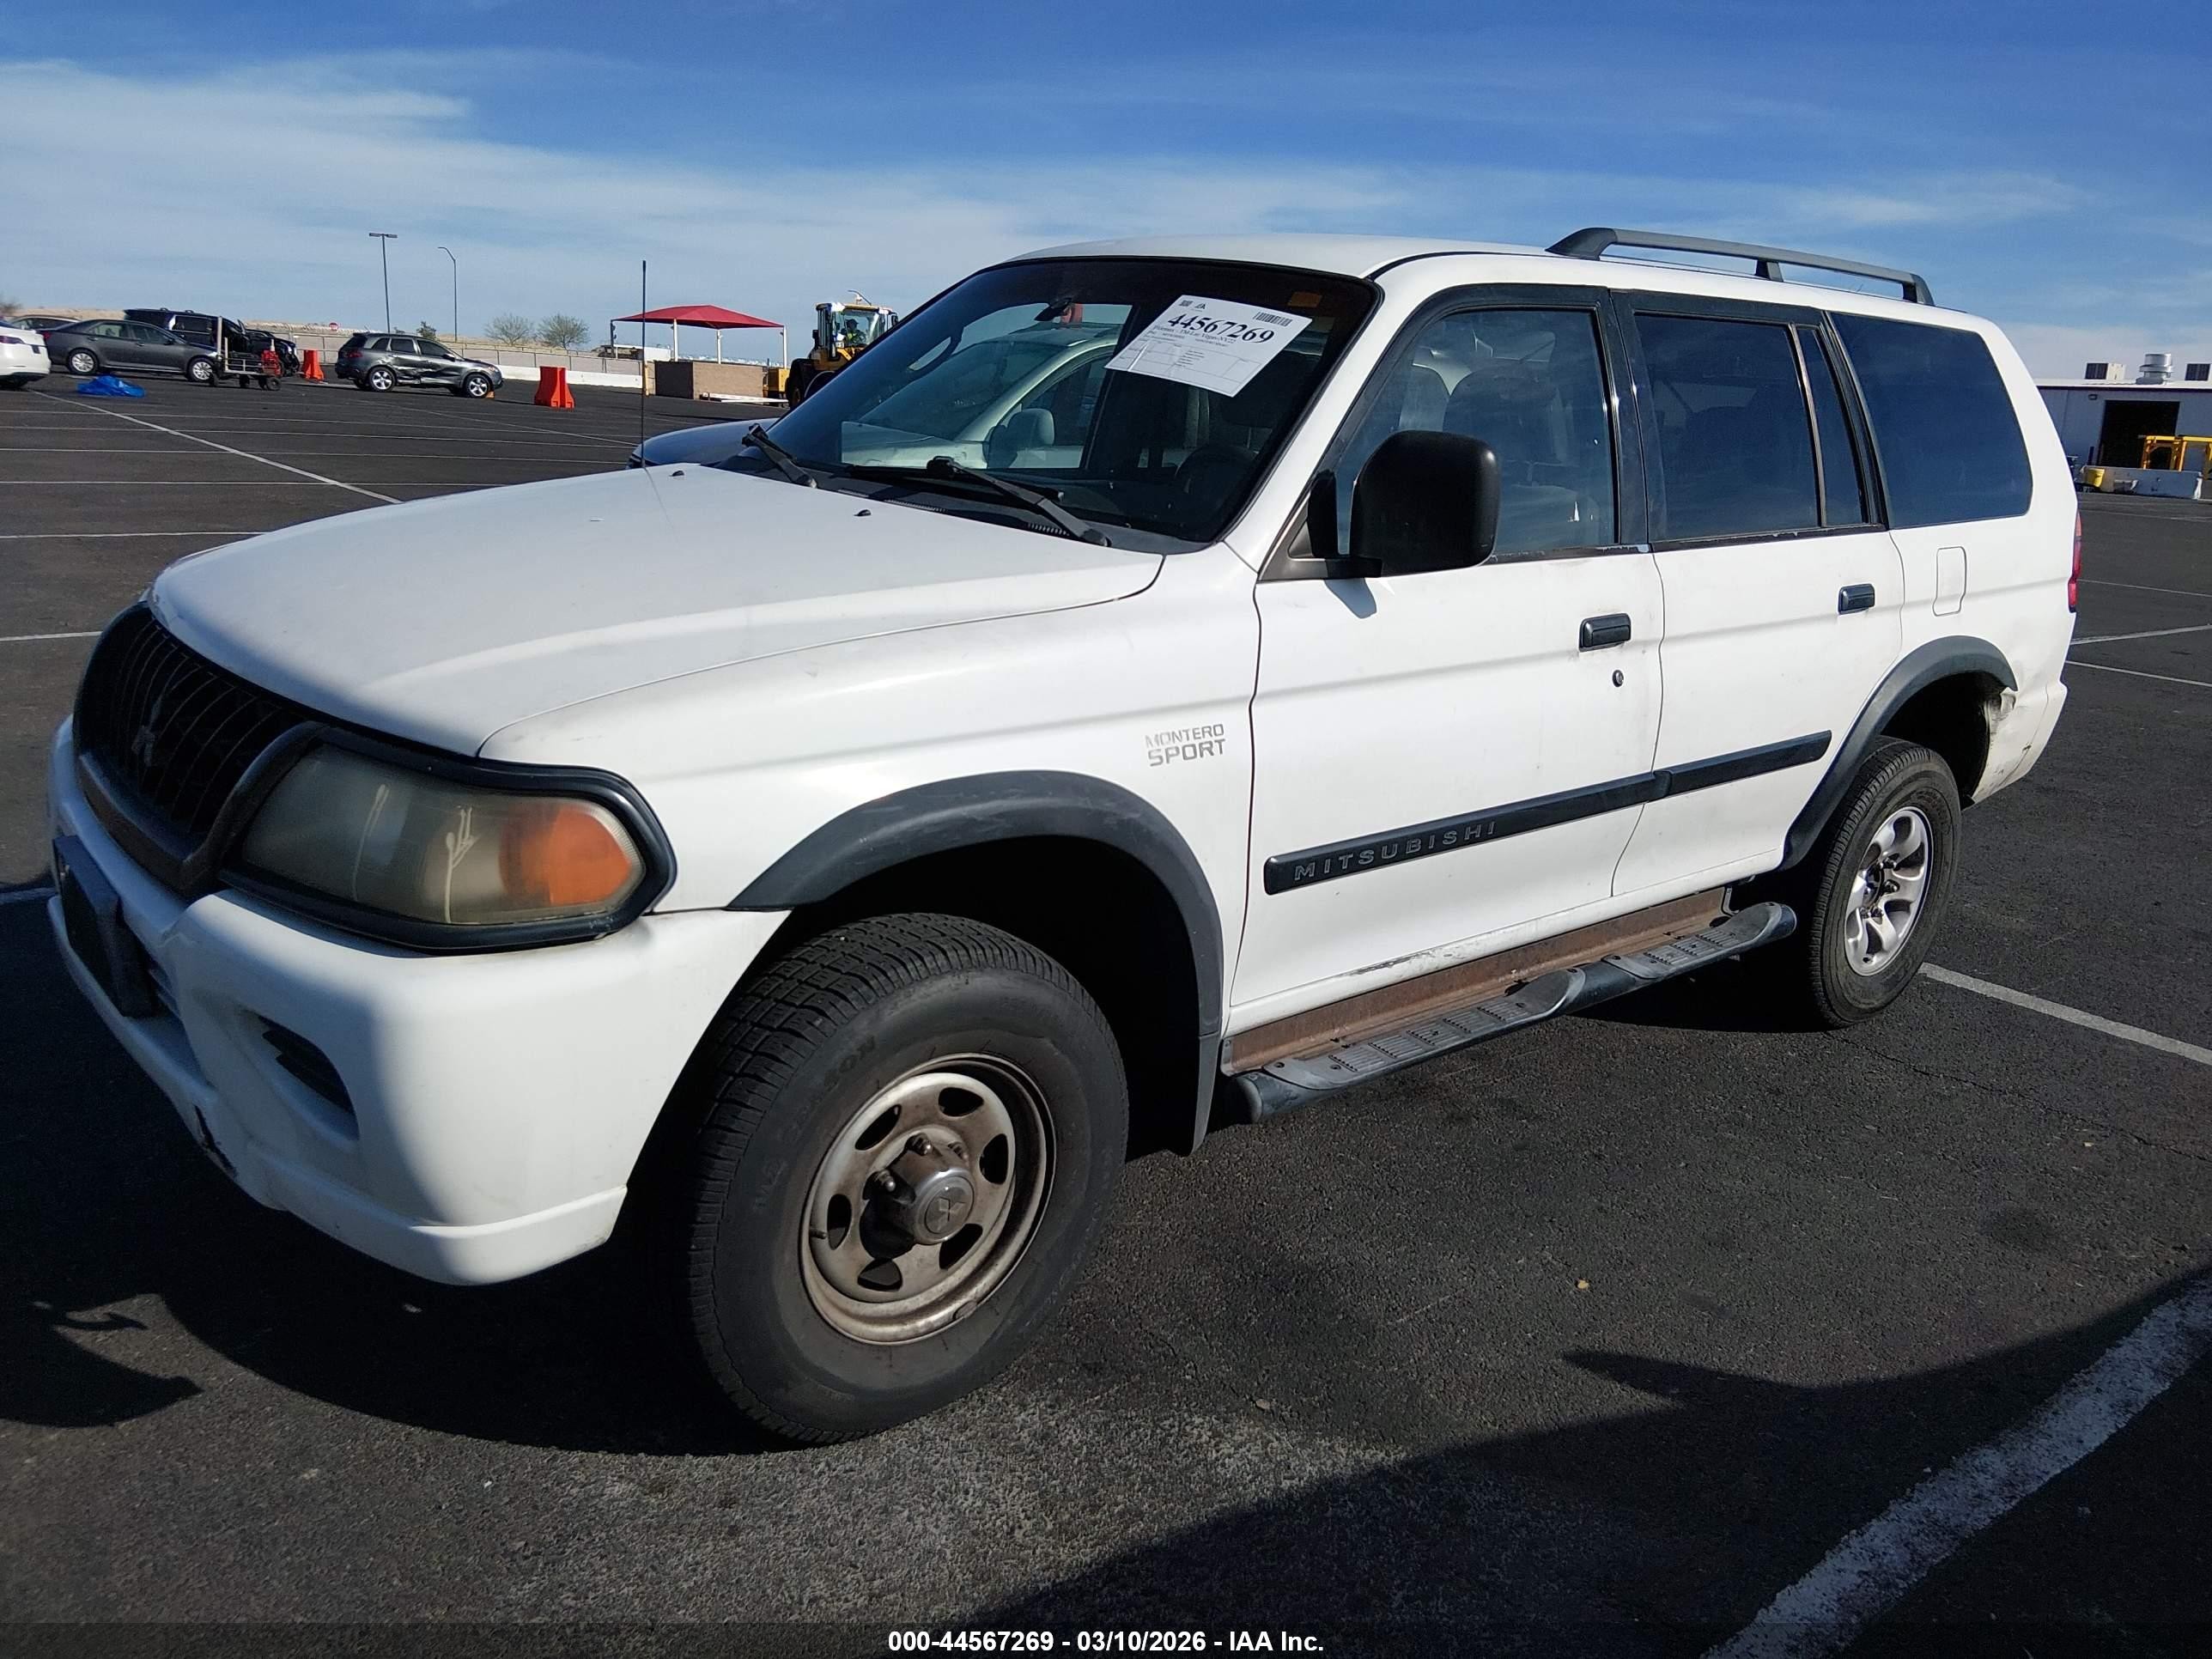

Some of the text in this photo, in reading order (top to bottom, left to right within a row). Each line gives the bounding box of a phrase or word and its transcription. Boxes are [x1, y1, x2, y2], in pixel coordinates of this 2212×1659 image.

[1168, 313, 1275, 343] 44567269
[1145, 723, 1224, 748] MONTERO
[1147, 738, 1226, 767] SPORT
[1293, 820, 1497, 881] MITSUBISHI
